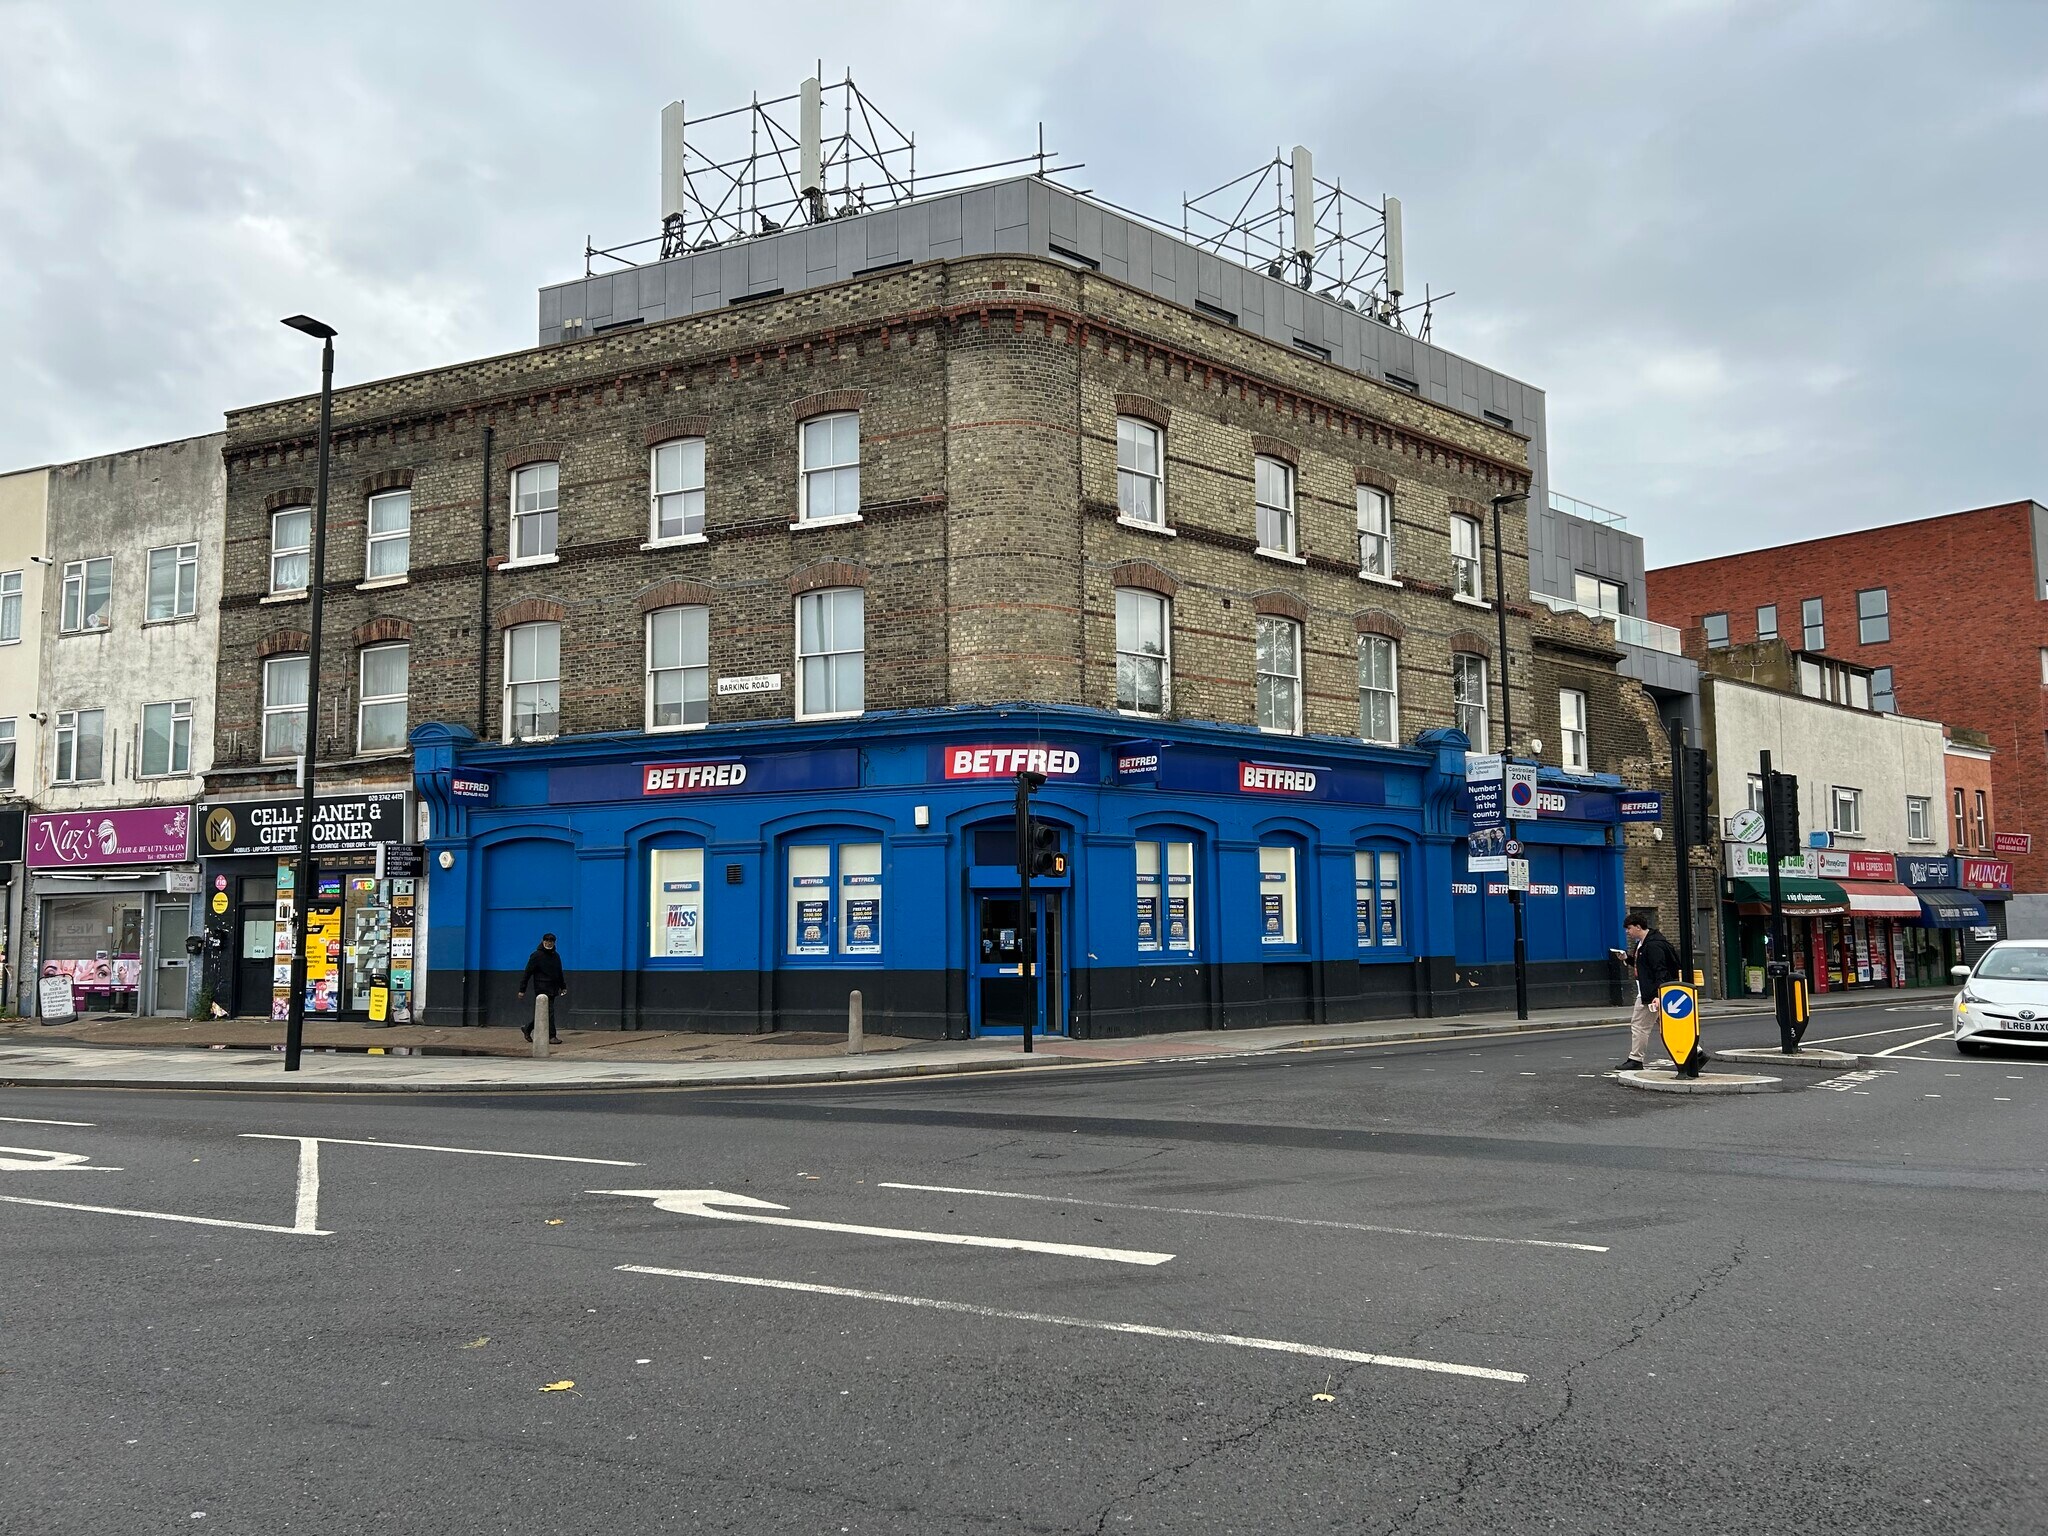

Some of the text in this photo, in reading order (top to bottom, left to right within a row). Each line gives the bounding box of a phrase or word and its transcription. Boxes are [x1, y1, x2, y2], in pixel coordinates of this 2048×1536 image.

[720, 681, 770, 692] BARKING ROAD
[954, 749, 1080, 774] BETFRED
[1120, 756, 1158, 768] BETFRED
[1508, 766, 1535, 774] Controlled
[647, 764, 747, 790] BETFRED
[1244, 767, 1316, 792] BETFRED
[454, 781, 489, 792] BETFRED
[1468, 785, 1495, 794] Number
[1474, 793, 1497, 801] school
[1537, 793, 1566, 811] FRED
[1622, 802, 1658, 811] BETFRED
[251, 808, 293, 826] CELL
[369, 804, 382, 820] &
[1472, 811, 1500, 819] country
[260, 822, 373, 844] GIFT ORNER
[35, 819, 94, 862] Naz's
[1997, 836, 2027, 846] MUNCH
[139, 845, 162, 853] BEAUTY
[1507, 843, 1518, 851] 20
[1055, 857, 1064, 872] 10
[1826, 860, 1847, 868] MoneyGram
[1853, 861, 1893, 872] Y & M EXPRESS LTD
[1969, 864, 2008, 883] MUNCH
[1530, 884, 1559, 895] BETFRED
[1568, 885, 1596, 895] BETFRED
[667, 911, 696, 927] MISS
[2007, 1022, 2031, 1030] LR68
